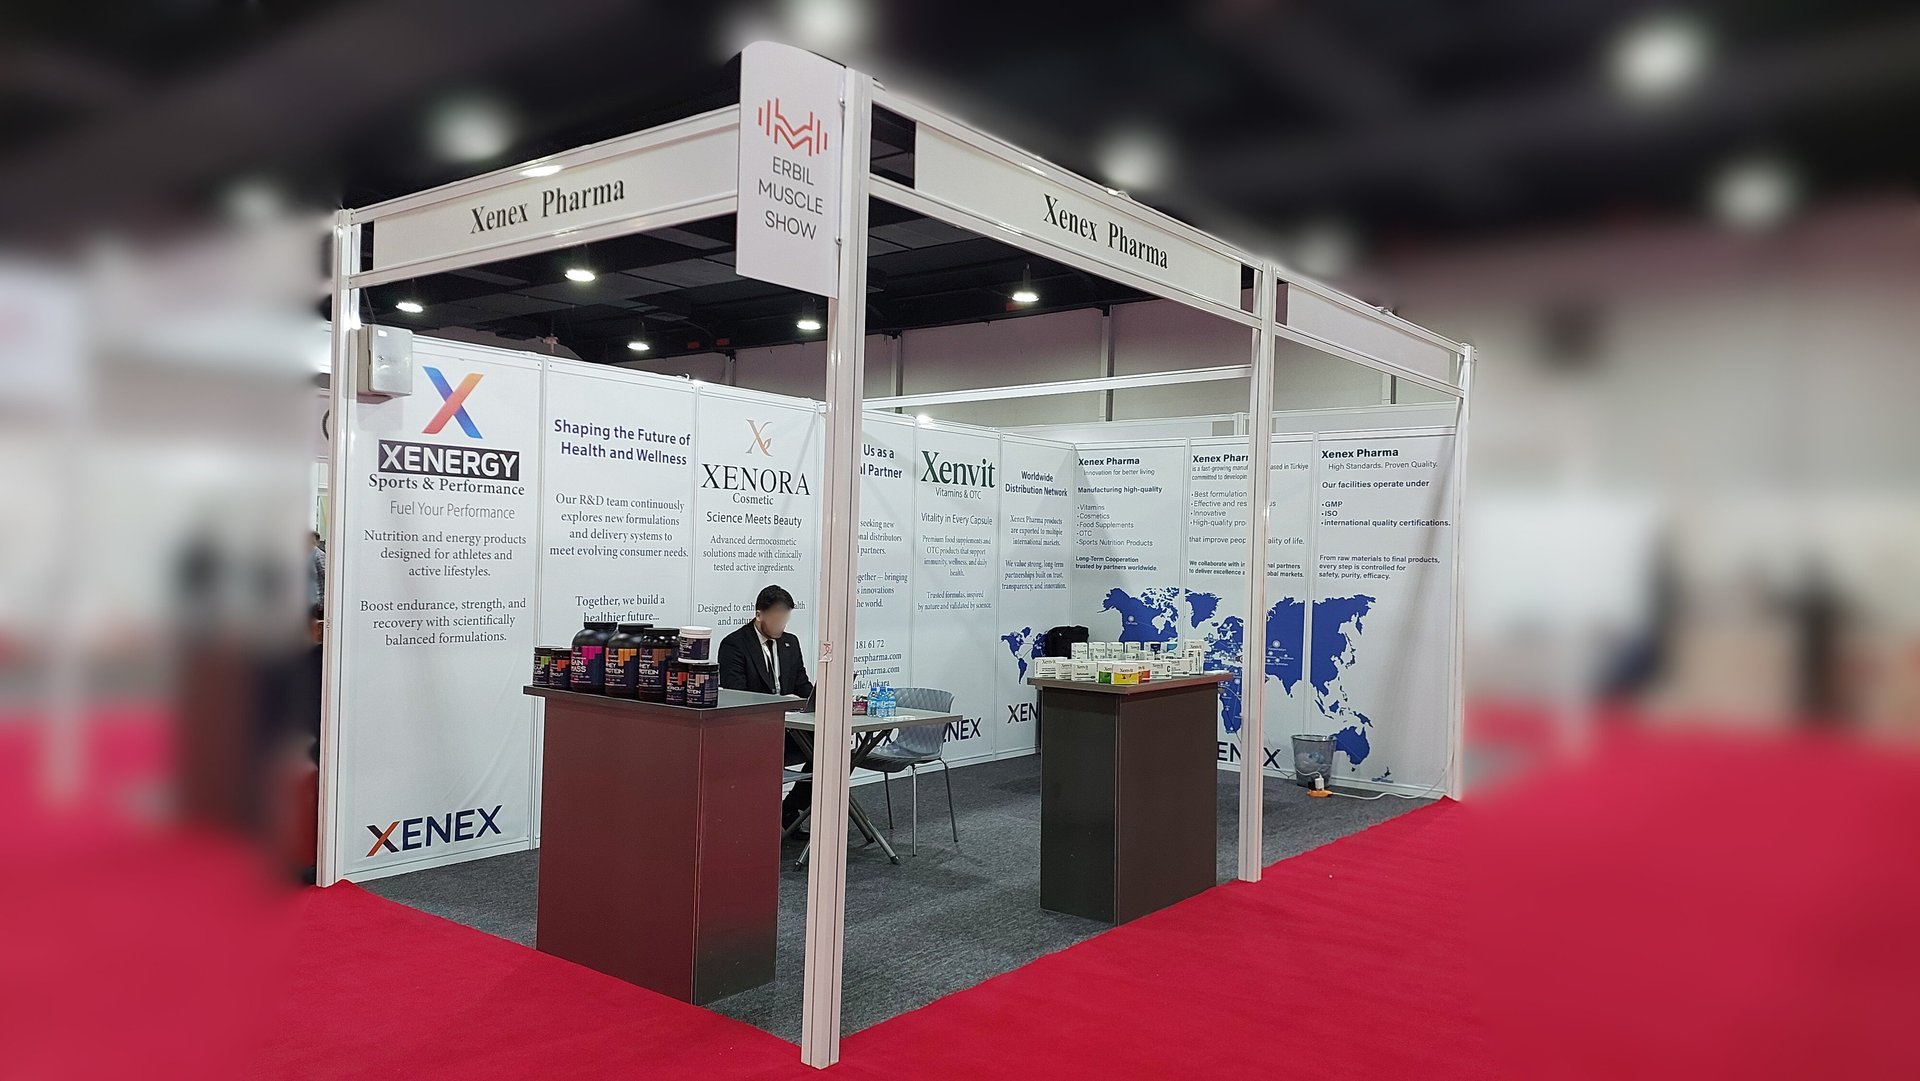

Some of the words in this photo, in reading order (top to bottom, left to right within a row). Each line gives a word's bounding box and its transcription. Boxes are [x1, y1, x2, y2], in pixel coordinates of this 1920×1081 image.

[772, 156, 814, 186] ERBIL
[758, 178, 823, 215] MUSCLE
[470, 203, 528, 235] Xenex
[541, 179, 624, 219] Pharma
[765, 210, 816, 240] SHOW
[1044, 194, 1098, 242] Xenex
[1108, 221, 1168, 269] Pharma
[555, 419, 610, 440] Shaping
[614, 426, 634, 440] the
[638, 429, 676, 444] Future
[679, 434, 690, 445] of
[561, 442, 605, 458] Health
[610, 448, 633, 460] and
[637, 449, 686, 465] Wellness
[864, 444, 875, 456] Us
[877, 448, 886, 458] as
[889, 450, 894, 458] a
[1322, 450, 1354, 458] Xenex
[1357, 449, 1398, 457] Pharma
[381, 444, 517, 477] XENERGY
[868, 464, 902, 478] Partner
[921, 450, 995, 488] Xenvit
[701, 464, 810, 495] XENORA
[1022, 471, 1053, 482] Worldwide
[369, 474, 418, 491] Sports
[423, 478, 434, 490] &
[440, 478, 524, 495] Performance
[1006, 484, 1042, 494] Distribution
[1044, 487, 1067, 496] Network
[733, 493, 774, 505] Cosmetic
[936, 487, 962, 498] Vitamins
[964, 490, 968, 498] &
[970, 490, 981, 499] OTC
[391, 501, 414, 514] Fuel
[418, 502, 443, 516] Your
[447, 503, 515, 519] Performance
[556, 493, 577, 504] Our
[580, 494, 604, 506] R&D
[607, 498, 628, 507] team
[631, 499, 684, 513] continuously
[561, 512, 602, 524] explores
[605, 514, 624, 523] new
[626, 514, 679, 525] formulations
[707, 511, 742, 523] Science
[745, 514, 771, 524] Meets
[774, 515, 802, 528] Beauty
[921, 513, 944, 524] Vitality
[945, 514, 951, 523] in
[953, 515, 969, 526] Every
[970, 516, 992, 525] Capsule
[364, 530, 418, 542] Nutrition
[422, 532, 442, 542] and
[446, 534, 480, 546] energy
[484, 533, 526, 546] products
[570, 528, 588, 539] and
[591, 528, 628, 543] delivery
[630, 532, 662, 543] systems
[665, 532, 672, 541] to
[710, 535, 745, 544] Advanced
[748, 536, 796, 545] dermocosmetic
[380, 548, 430, 561] designed
[434, 549, 449, 559] for
[453, 549, 491, 560] athletes
[494, 550, 512, 560] and
[550, 547, 574, 555] meet
[578, 545, 618, 559] evolving
[664, 548, 688, 557] needs.
[703, 549, 736, 557] solutions
[738, 550, 756, 558] made
[759, 550, 772, 558] with
[774, 551, 802, 560] clinically
[409, 566, 441, 576] active
[444, 565, 490, 579] lifestyles.
[714, 563, 734, 571] tested
[758, 564, 794, 574] ingredients.
[360, 601, 393, 611] Boost
[397, 599, 458, 611] endurance,
[461, 599, 505, 611] strength,
[508, 598, 526, 608] and
[575, 596, 620, 609] Together,
[637, 594, 658, 604] build
[697, 604, 731, 614] Designed
[373, 619, 423, 630] recovery
[427, 616, 450, 627] with
[453, 614, 515, 627] scientifically
[584, 612, 625, 622] healthier
[628, 611, 659, 621] future...
[386, 634, 435, 646] balanced
[439, 632, 506, 643] formulations.
[366, 805, 502, 857] XENEX
